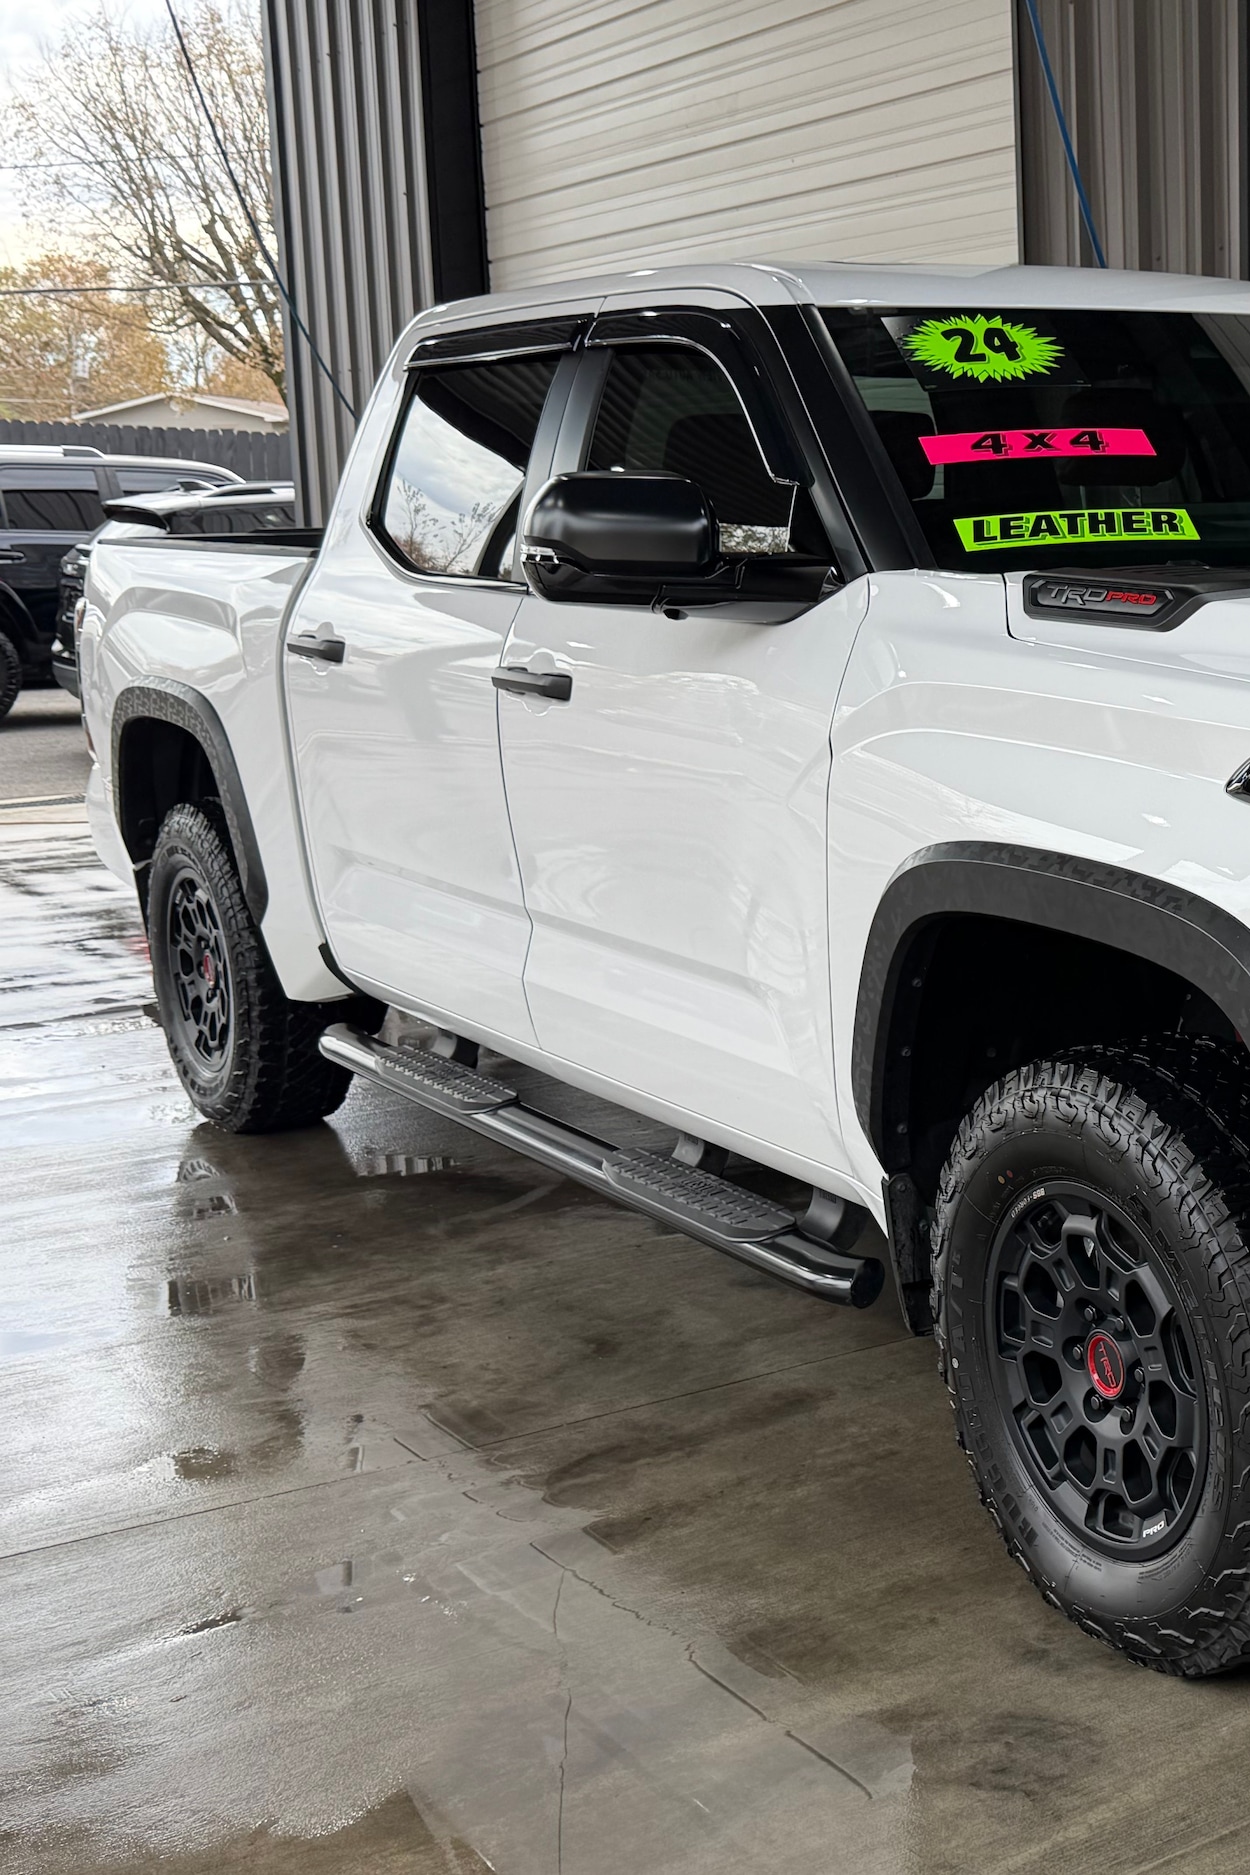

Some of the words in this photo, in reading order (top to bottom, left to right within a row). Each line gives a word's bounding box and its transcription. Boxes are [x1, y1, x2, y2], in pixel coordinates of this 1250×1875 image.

[941, 327, 1021, 363] 24
[972, 512, 1184, 543] LEATHER
[1046, 584, 1107, 606] TRD
[1106, 591, 1157, 606] PRO
[1099, 1341, 1116, 1388] TRD
[1143, 1521, 1167, 1538] PRO
